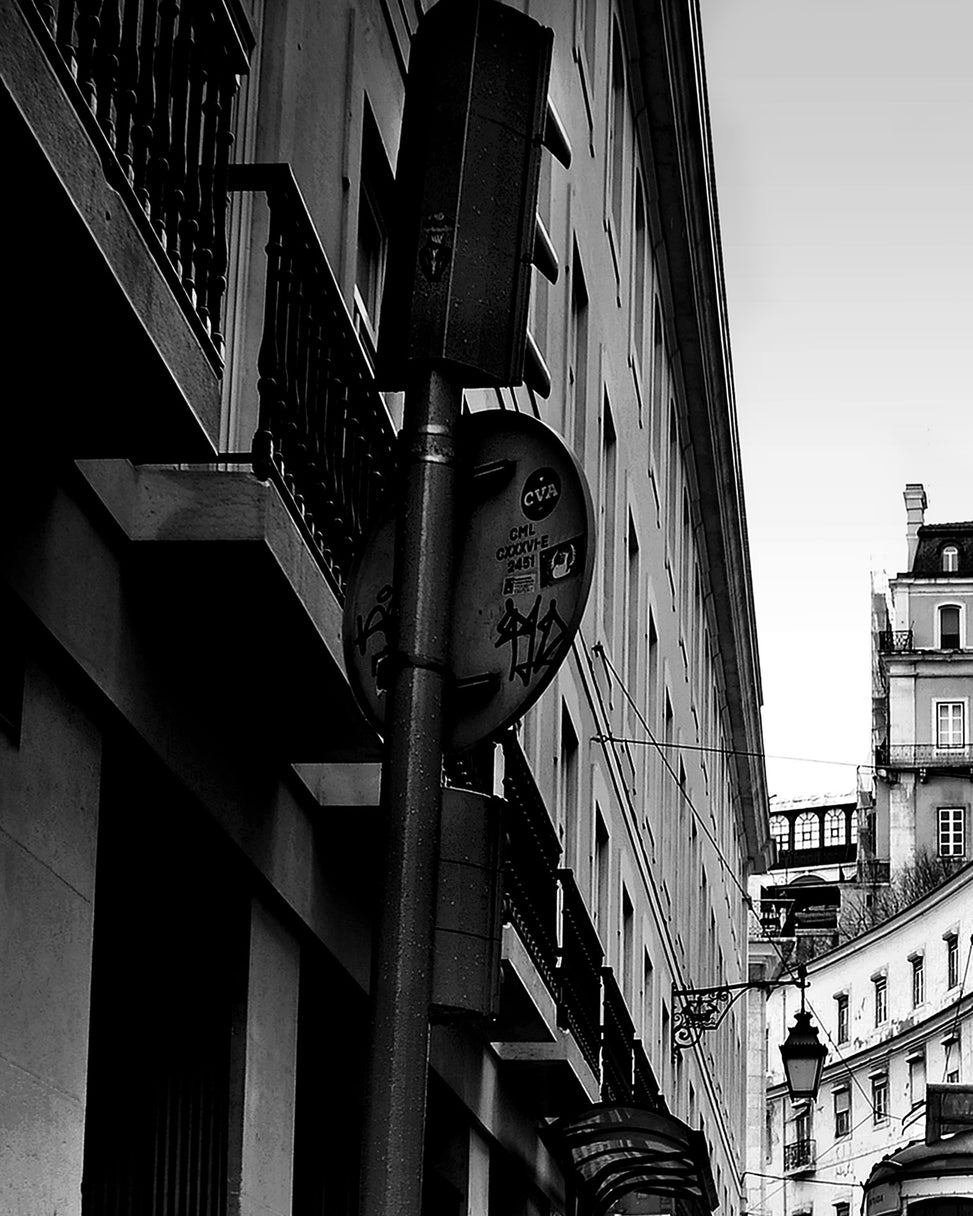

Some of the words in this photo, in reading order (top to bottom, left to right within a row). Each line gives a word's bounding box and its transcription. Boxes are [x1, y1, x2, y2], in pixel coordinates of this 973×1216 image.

[524, 483, 559, 507] CVA
[509, 523, 536, 541] CML
[507, 554, 535, 574] 2451
